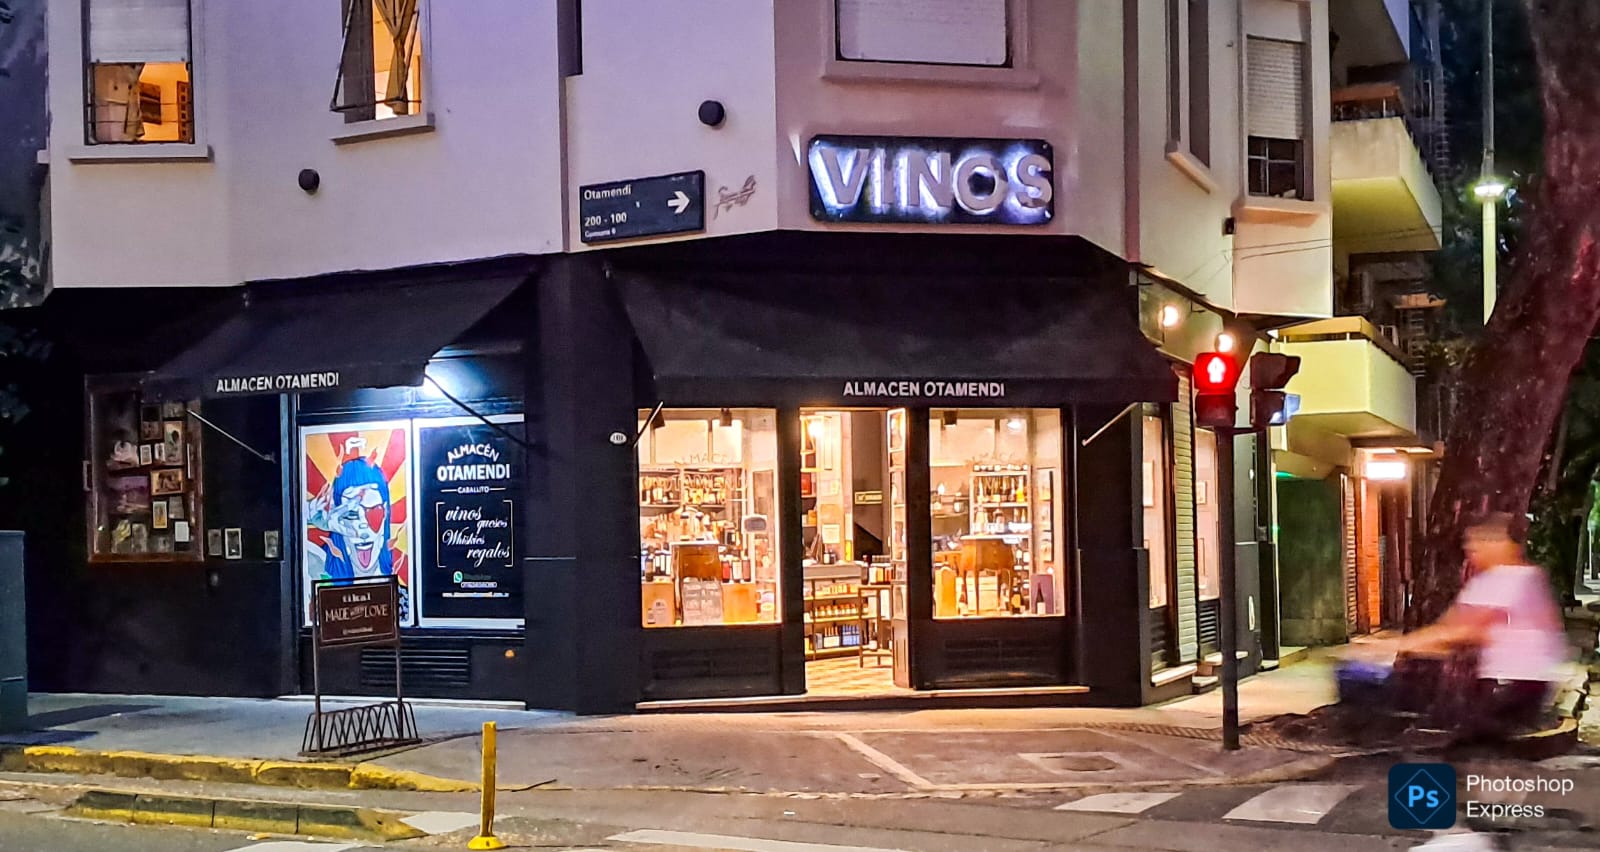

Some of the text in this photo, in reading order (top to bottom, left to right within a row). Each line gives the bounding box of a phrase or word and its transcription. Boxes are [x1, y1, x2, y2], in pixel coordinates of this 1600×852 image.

[810, 147, 1053, 215] VINOS
[584, 184, 632, 200] Otamendi
[584, 215, 602, 227] 200
[610, 212, 627, 224] 100
[216, 372, 340, 392] ALMACEN OTAMENDI
[843, 381, 1005, 397] ALMACEN OTAMENDI
[447, 443, 500, 464] ALMACÉN
[436, 463, 511, 482] OTAMENDI
[457, 485, 490, 494] CABALLITO
[445, 505, 483, 521] vinos
[476, 517, 509, 535] quesos
[442, 526, 486, 547] Whiskies
[466, 541, 511, 568] regalos
[342, 592, 371, 603] tikal
[325, 607, 350, 623] MADE
[364, 603, 389, 618] LOVE
